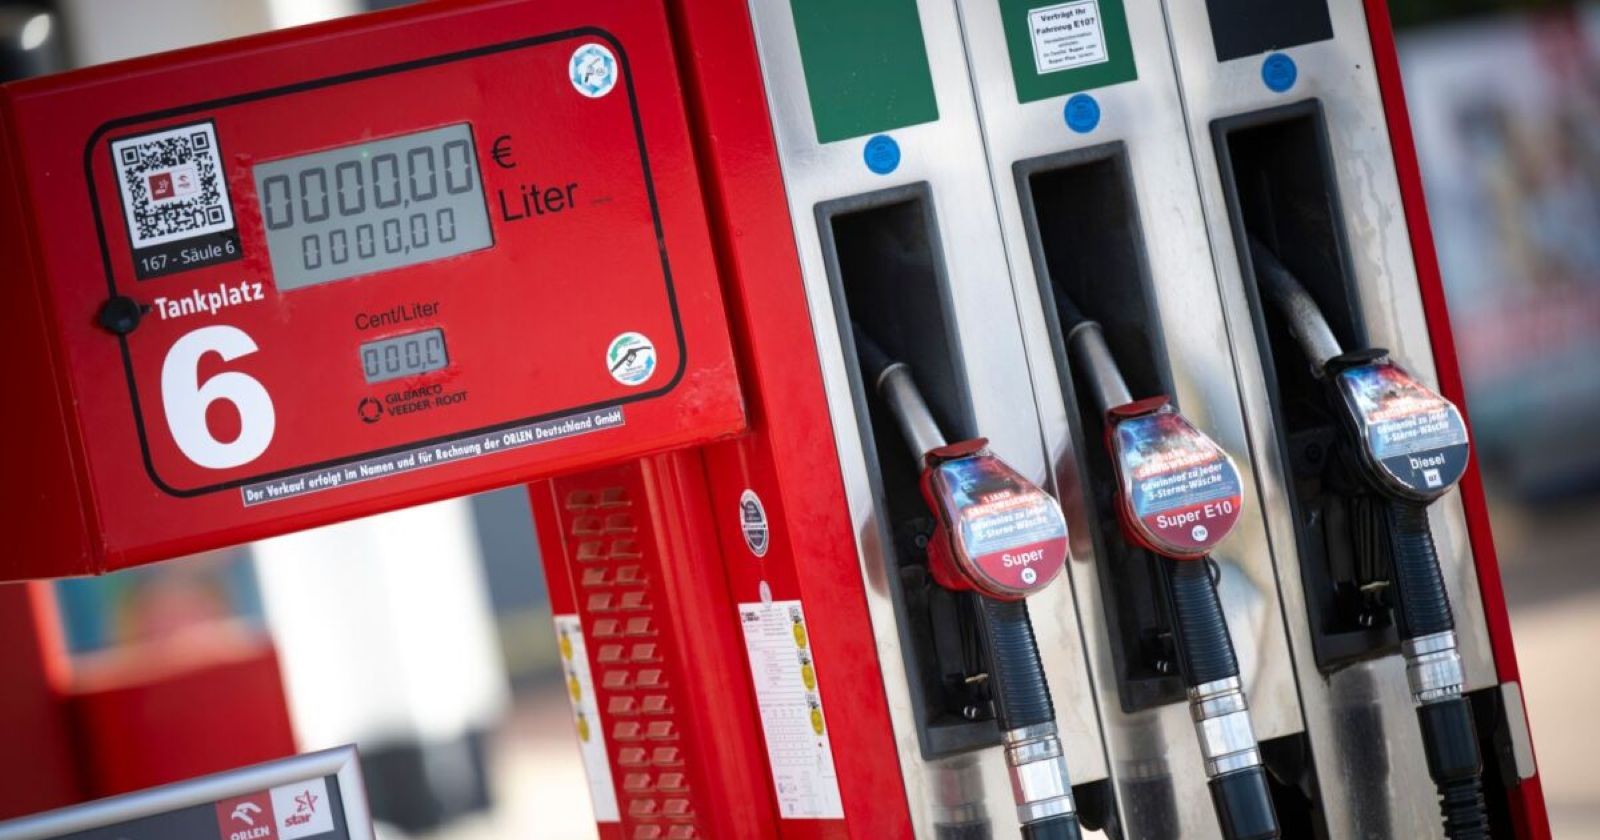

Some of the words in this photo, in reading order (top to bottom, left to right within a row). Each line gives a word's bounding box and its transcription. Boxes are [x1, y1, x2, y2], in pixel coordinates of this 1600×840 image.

[491, 135, 517, 169] €
[498, 182, 578, 222] Liter
[141, 256, 167, 273] 167
[181, 244, 222, 265] Säule
[225, 240, 236, 254] 6
[155, 281, 265, 320] Tankplatz
[355, 301, 440, 330] Cent/Liter
[161, 324, 277, 470] 6
[385, 384, 443, 404] GILBARCO
[246, 489, 264, 501] Der
[266, 481, 305, 497] Verkauf
[308, 472, 342, 487] erfolgt
[345, 468, 357, 479] im
[360, 462, 394, 477] Namen
[397, 456, 414, 468] und
[418, 452, 432, 464] für
[436, 442, 482, 461] Rechnung
[484, 438, 500, 450] der
[503, 431, 534, 446] ORLEN
[536, 416, 592, 438] Deutschland
[595, 410, 622, 426] GmbH
[1409, 453, 1446, 470] Diesel
[1156, 509, 1200, 529] Super
[1204, 500, 1233, 519] E10
[1002, 549, 1044, 568] Super
[230, 825, 270, 840] ORLEN
[284, 813, 313, 828] star
